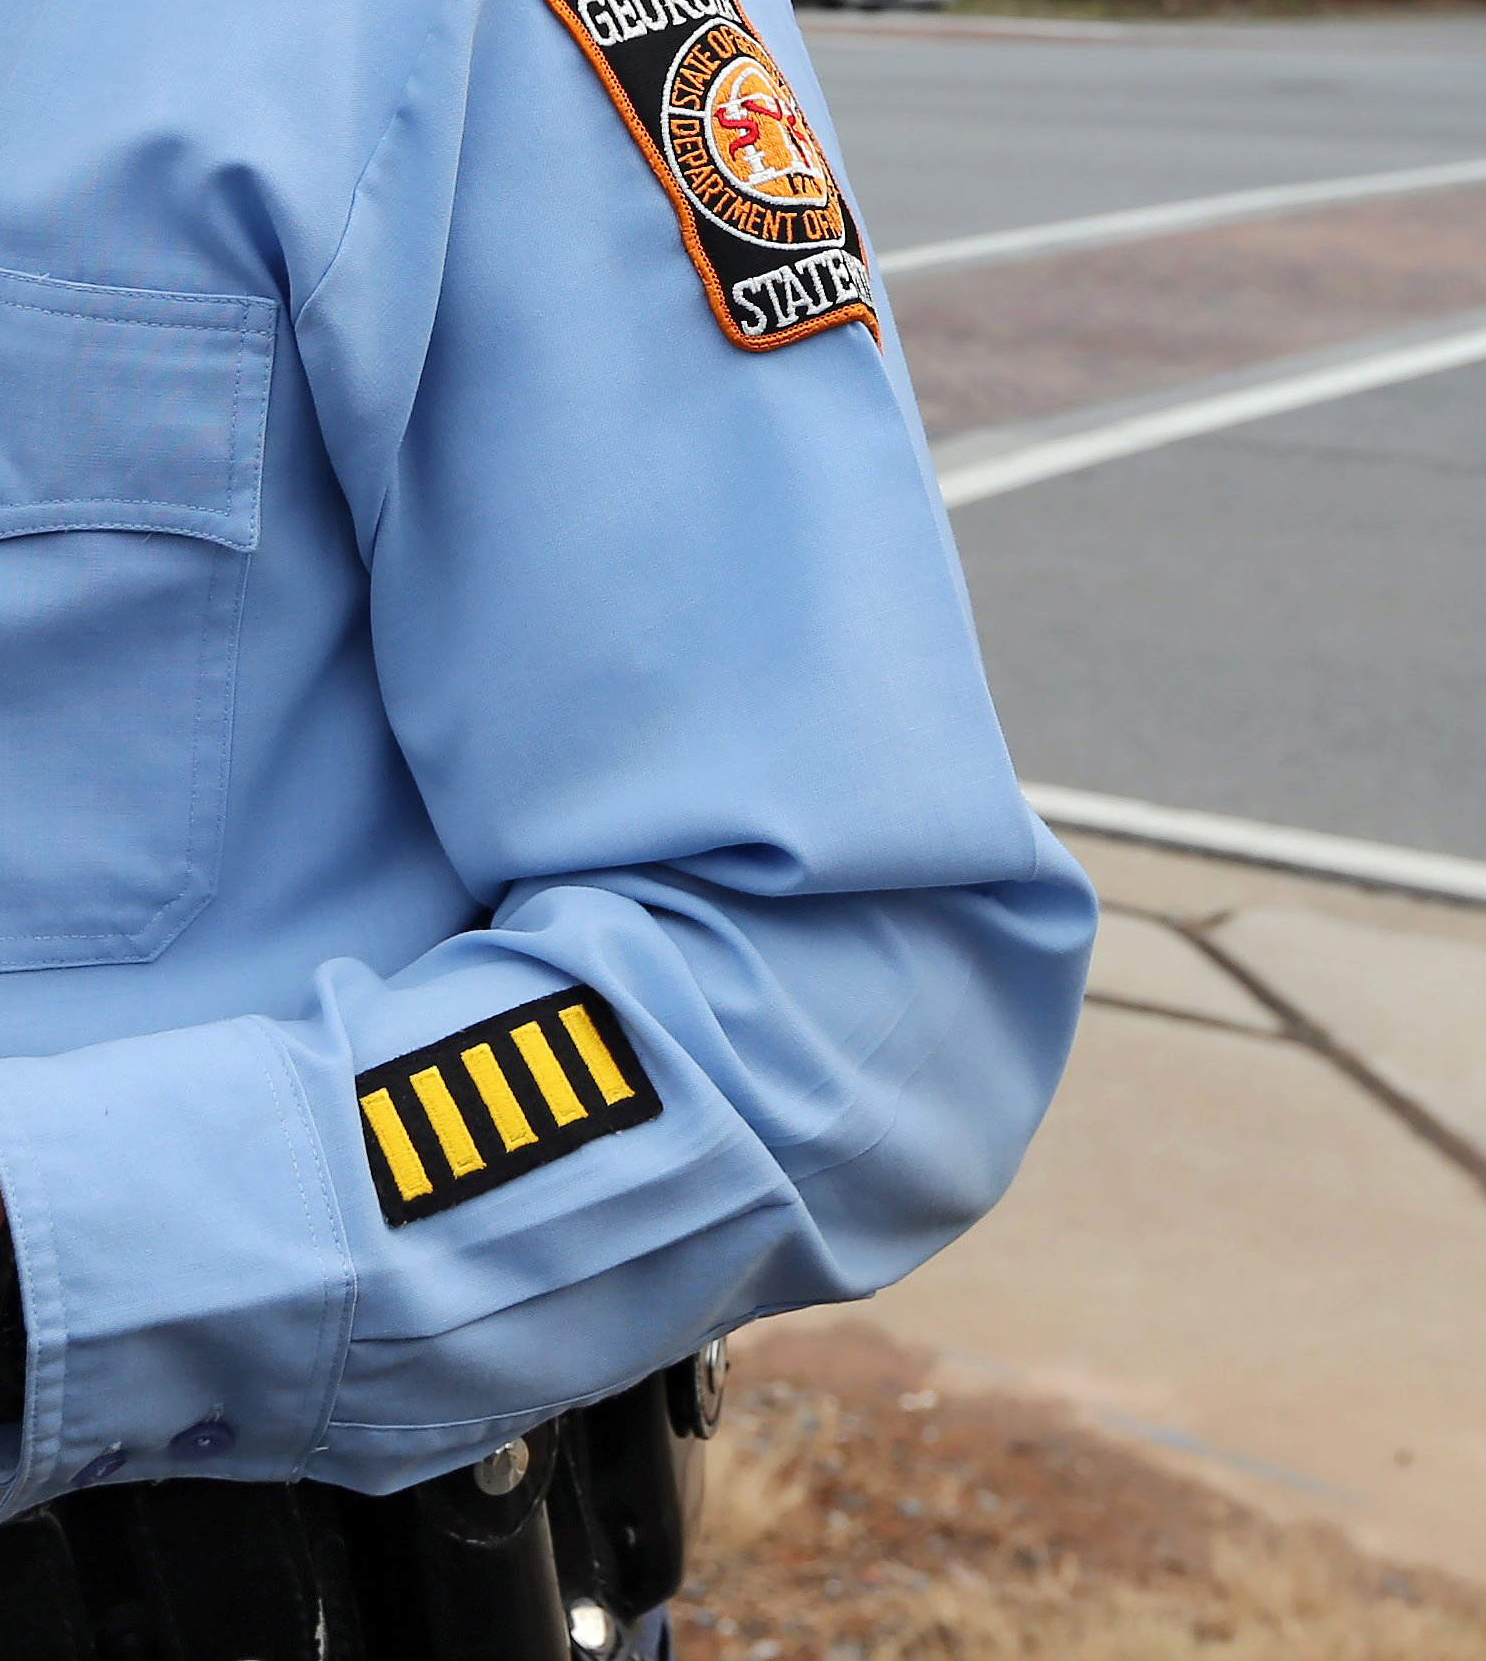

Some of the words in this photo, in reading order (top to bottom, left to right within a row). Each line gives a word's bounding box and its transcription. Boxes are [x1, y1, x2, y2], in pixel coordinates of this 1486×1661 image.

[671, 41, 721, 111] STATE
[707, 25, 738, 58] OF
[670, 119, 797, 244] DEPARTMENT
